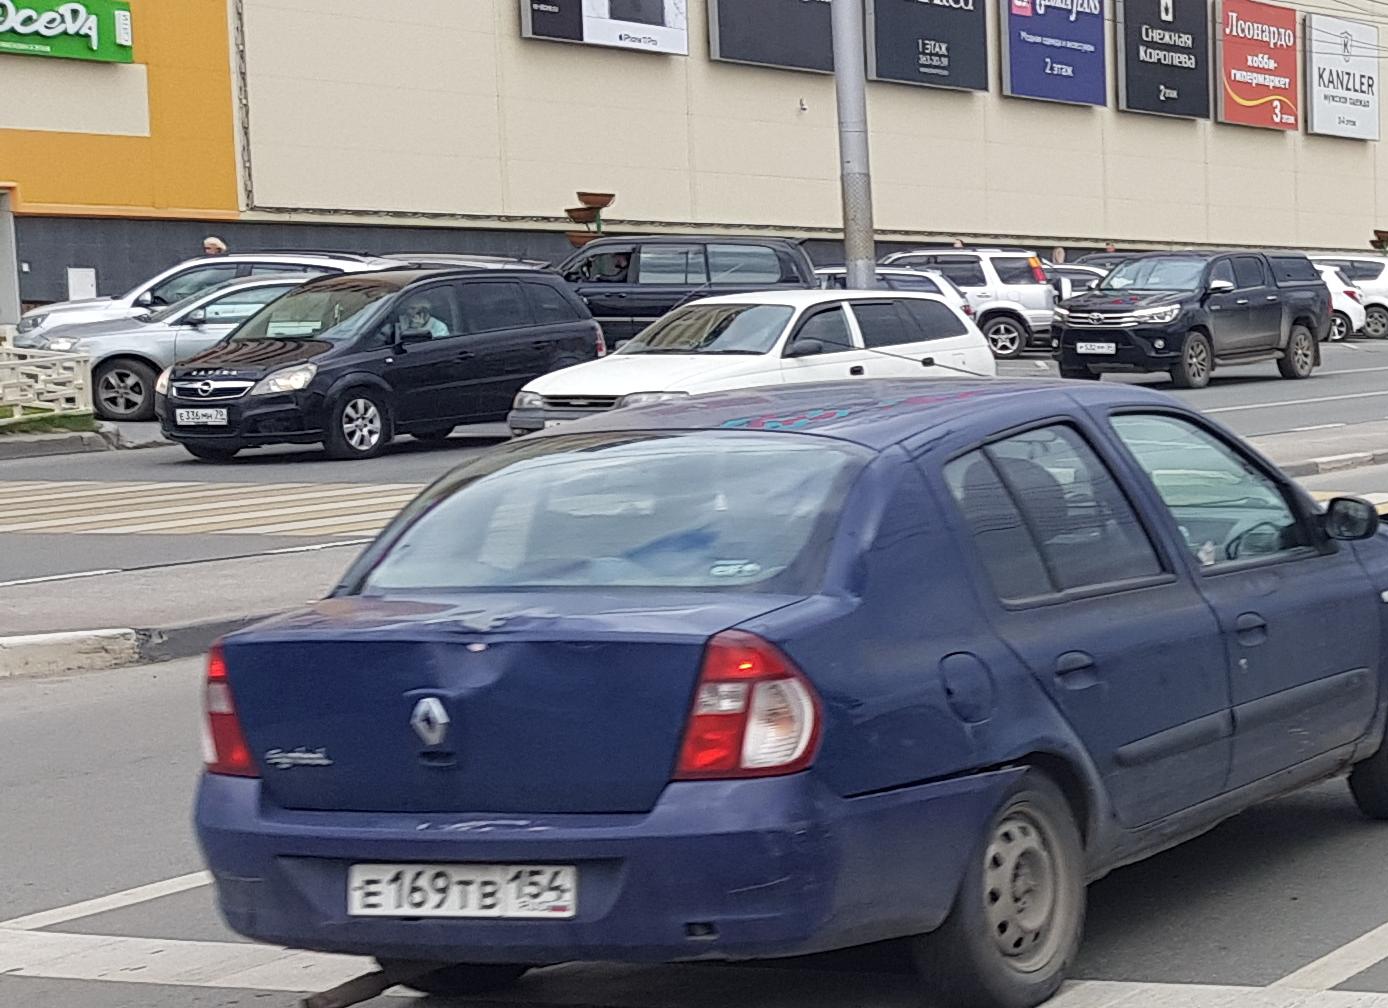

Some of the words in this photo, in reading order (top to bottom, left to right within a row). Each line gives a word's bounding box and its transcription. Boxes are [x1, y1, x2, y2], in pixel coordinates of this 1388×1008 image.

[1141, 25, 1192, 48] Снежная
[1225, 12, 1294, 48] Леонардо
[923, 40, 948, 56] ЭТАЖ
[1138, 45, 1196, 68] Королева
[1045, 58, 1052, 74] 2
[1317, 67, 1375, 96] KANZLER
[1272, 100, 1281, 122] 3
